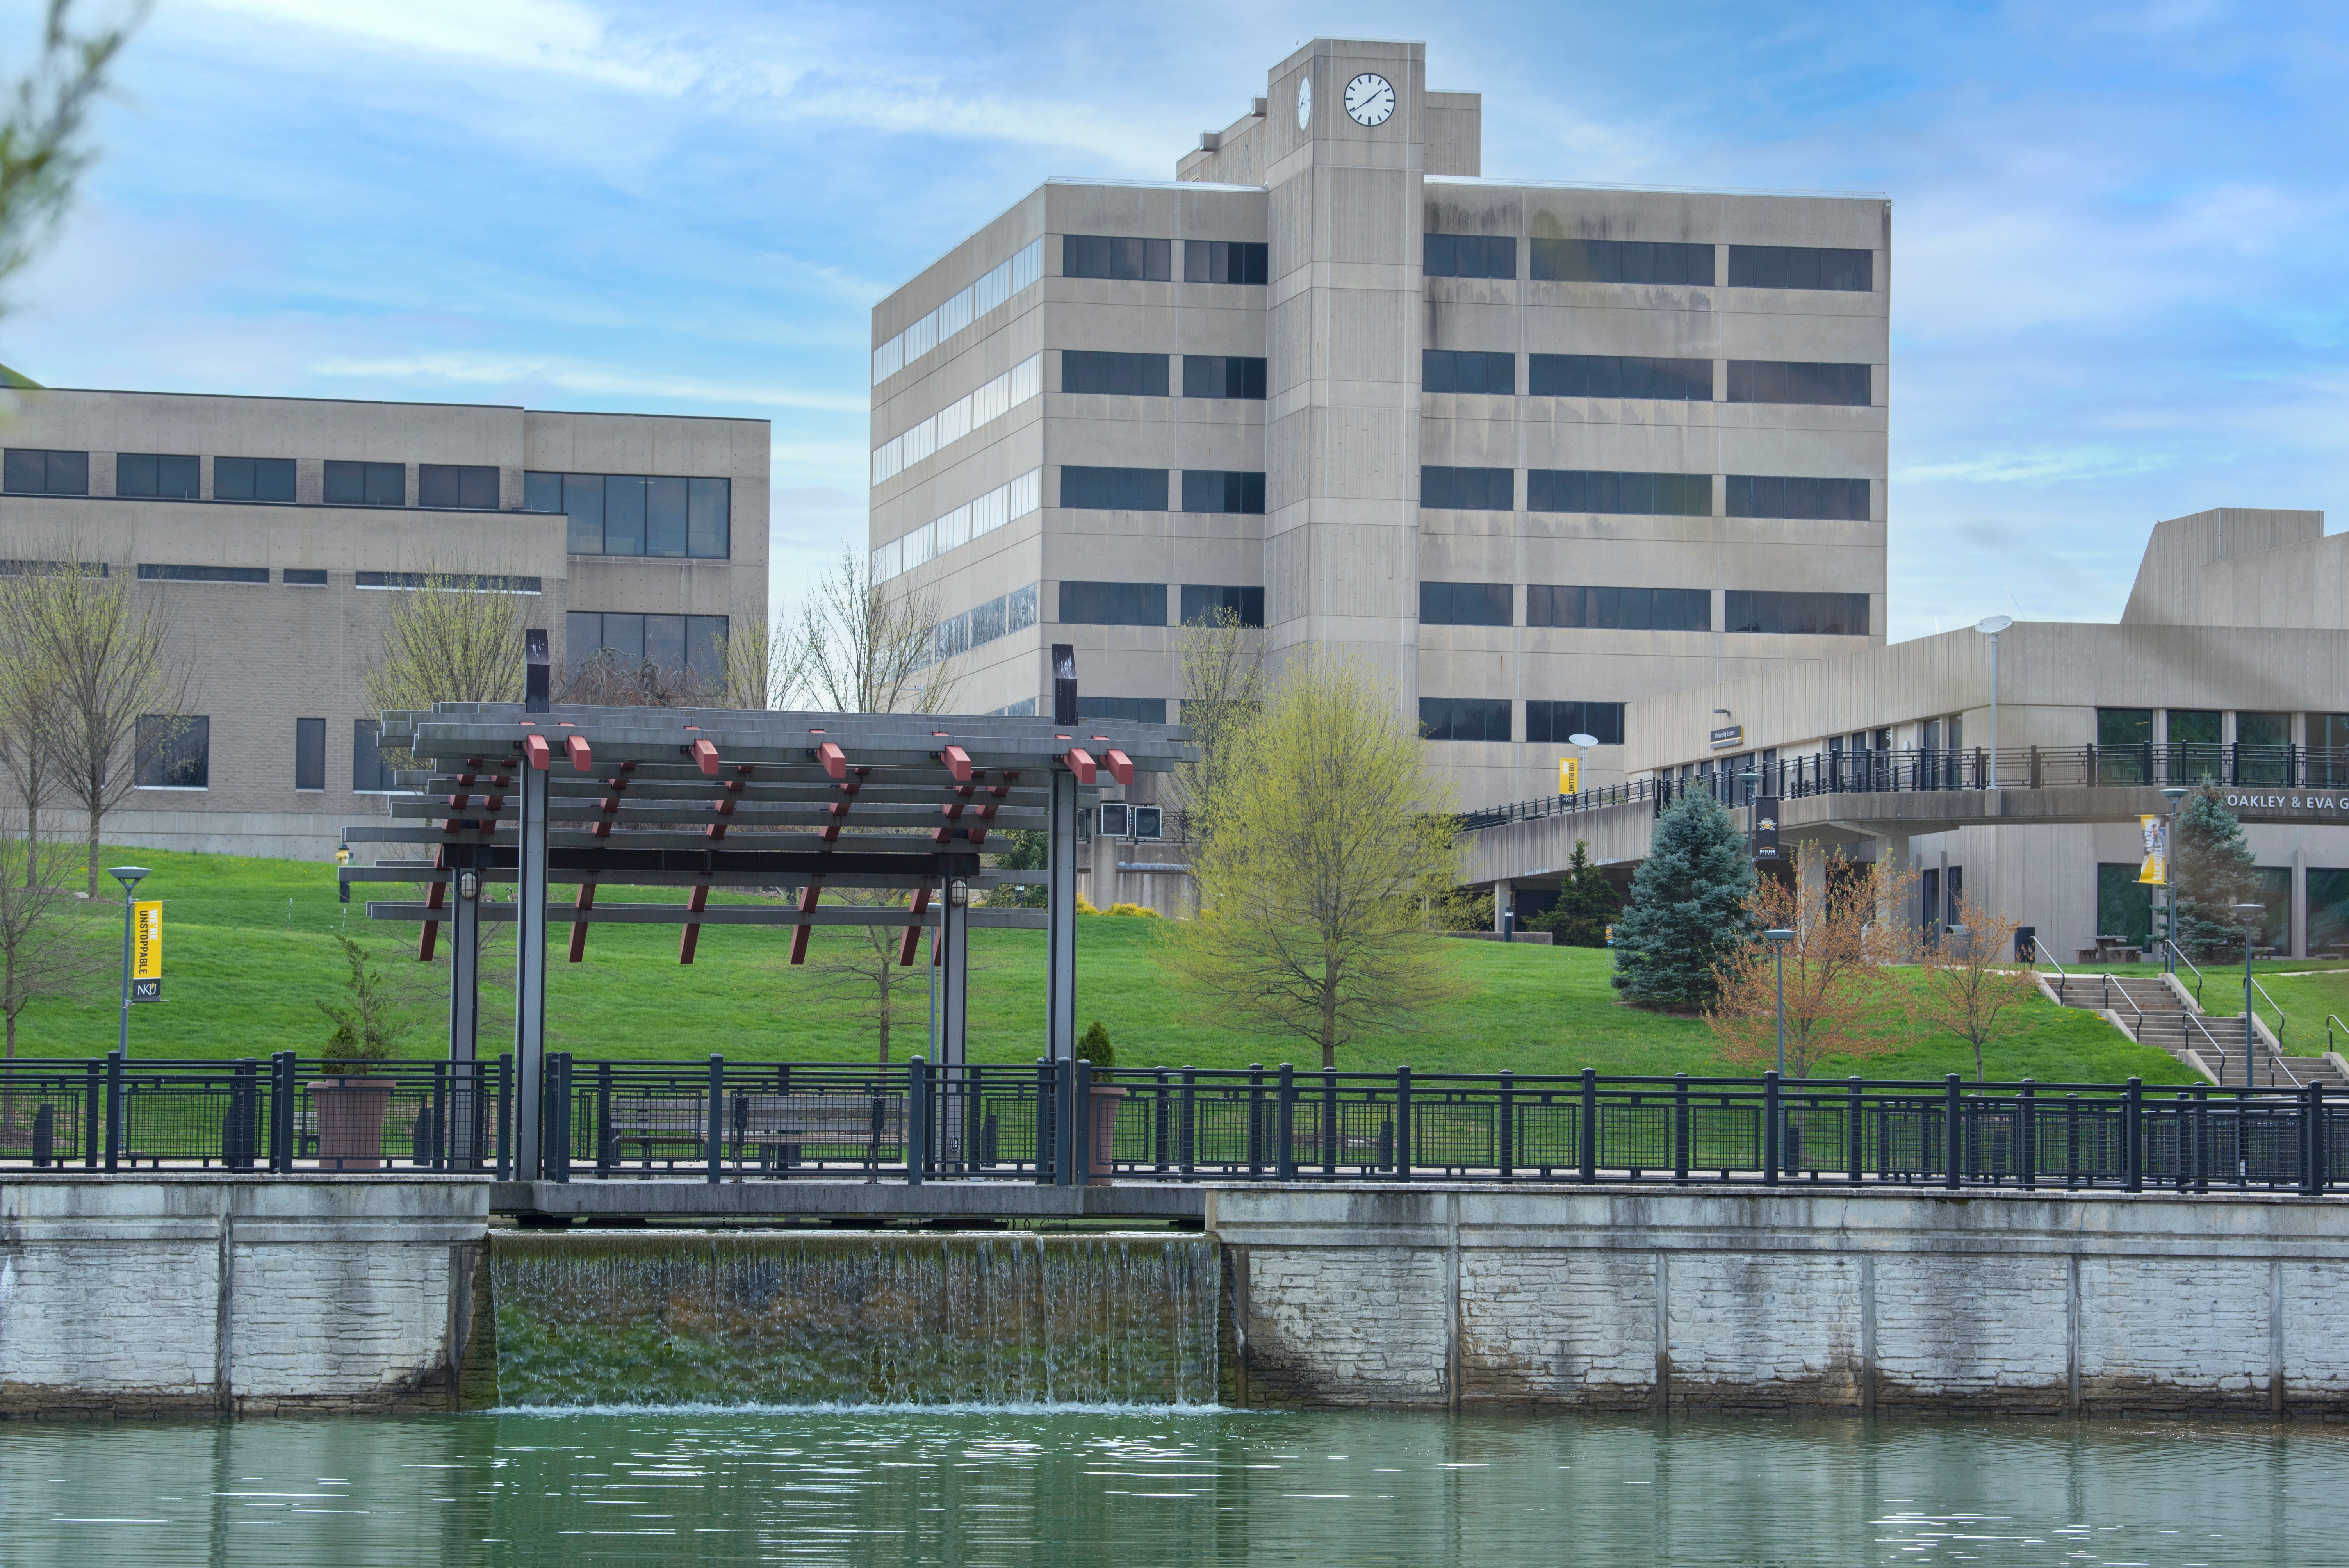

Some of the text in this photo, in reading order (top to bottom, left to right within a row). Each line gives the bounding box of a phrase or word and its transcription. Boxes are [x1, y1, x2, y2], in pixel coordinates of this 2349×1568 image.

[2227, 795, 2285, 807] OAKLEY
[2291, 797, 2301, 808] &
[2307, 797, 2334, 809] EVA
[2144, 819, 2154, 852] AMAZING
[2153, 842, 2163, 880] STUDENTS
[149, 909, 158, 941] WE'RE
[139, 910, 148, 975] UNSTOPPABLE
[137, 984, 157, 996] NKU
